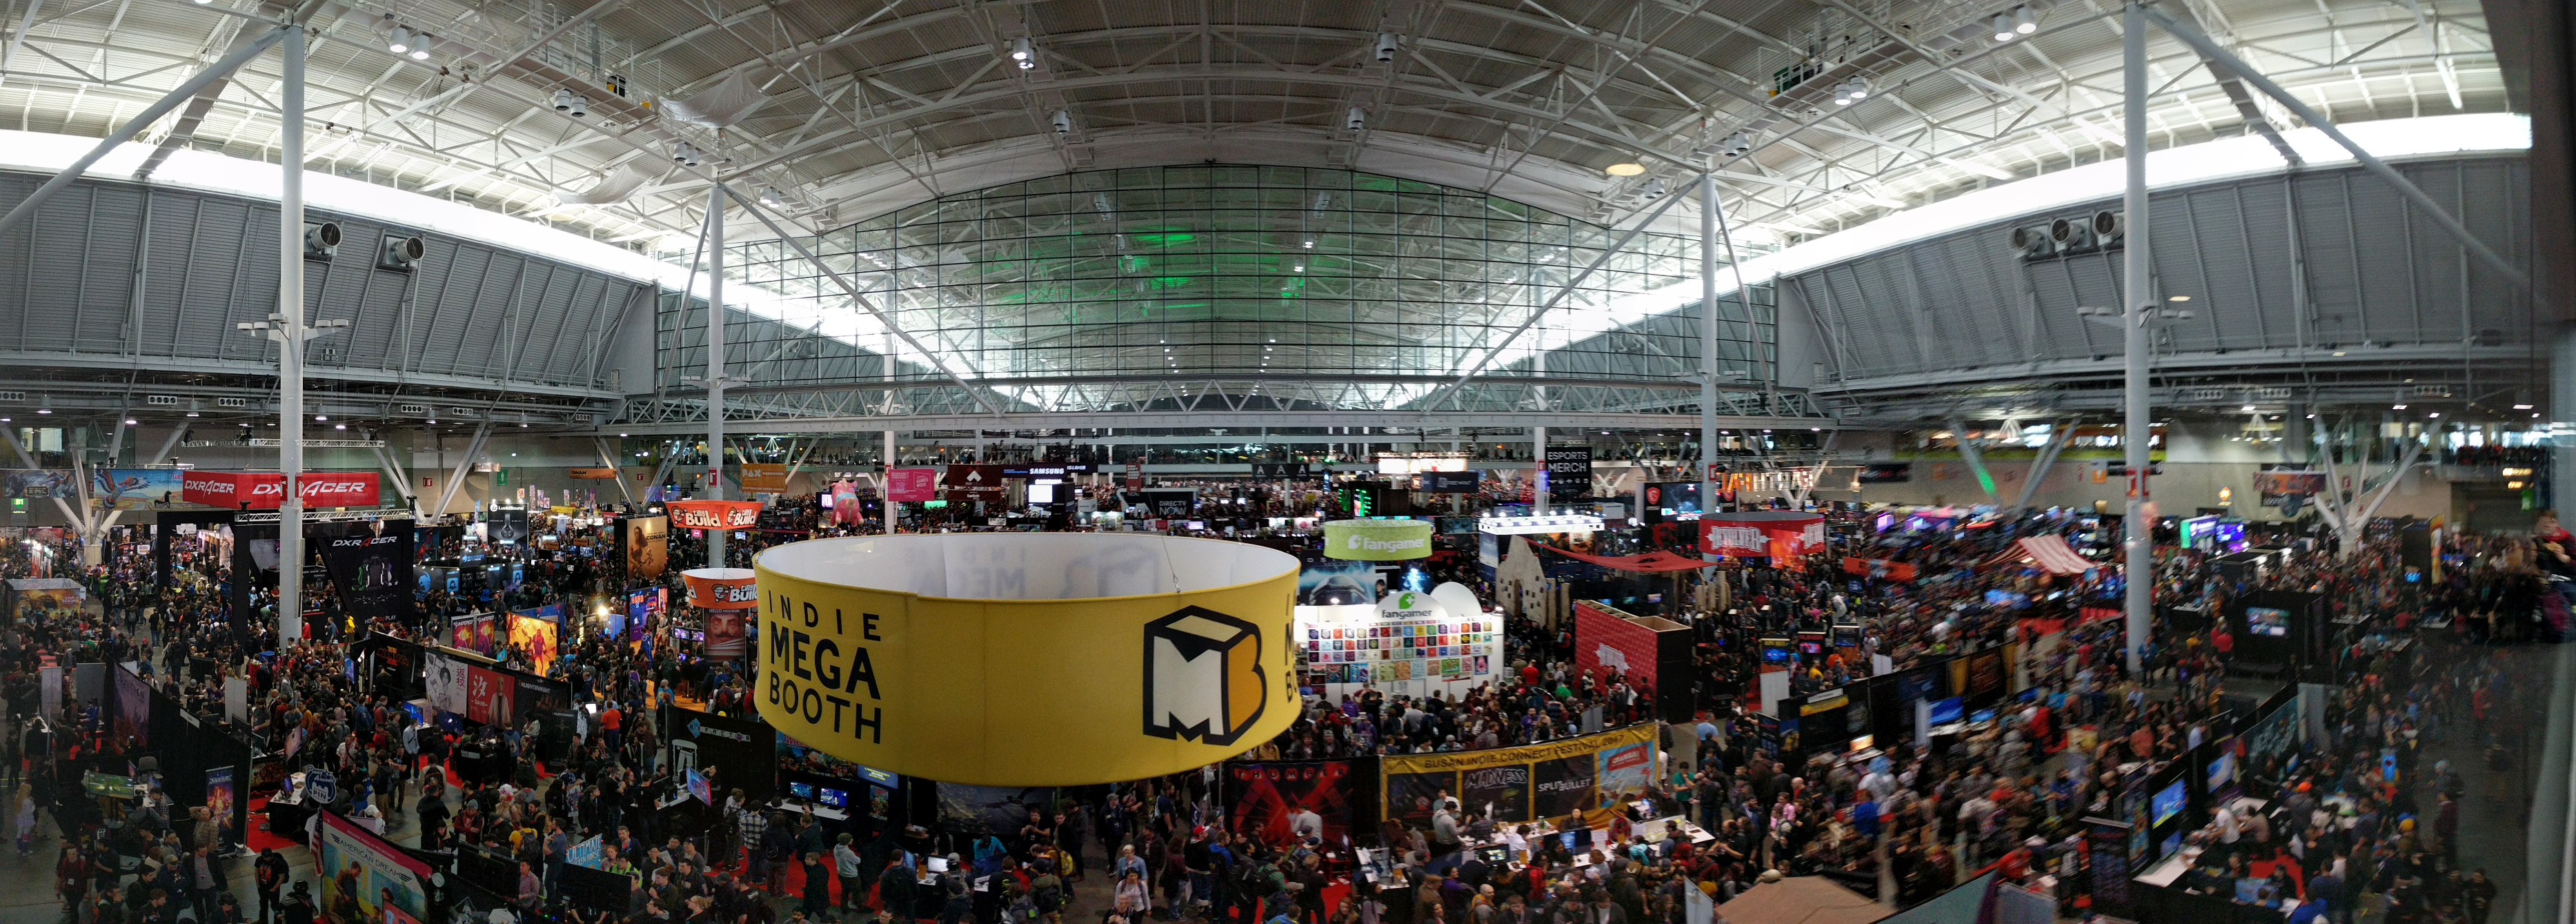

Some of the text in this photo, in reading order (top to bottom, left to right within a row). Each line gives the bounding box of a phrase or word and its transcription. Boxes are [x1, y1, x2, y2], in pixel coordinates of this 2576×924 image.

[1547, 451, 1588, 460] ESPORTS
[743, 469, 761, 478] PAX
[1549, 463, 1587, 473] MERCH
[184, 480, 235, 500] DXRACER
[252, 481, 366, 496] DXACER
[686, 509, 722, 527] Build
[733, 509, 757, 527] Build
[1159, 507, 1187, 515] NOW
[333, 535, 399, 551] DXRACER
[1363, 537, 1425, 553] fangamer
[631, 595, 644, 604] HARD
[768, 589, 880, 642] INDIE
[1382, 609, 1433, 620] fangamer
[770, 622, 881, 700] MEGA
[769, 671, 882, 745] BOOTH
[1425, 758, 1458, 769] BUSAN
[1463, 755, 1496, 765] INDIE
[1500, 752, 1552, 763] CONNECT
[1554, 742, 1600, 756] FESTIVAL
[313, 789, 326, 800] PIN
[567, 837, 602, 863] ULTIMATE
[339, 840, 401, 878] AMERICAN DREAM
